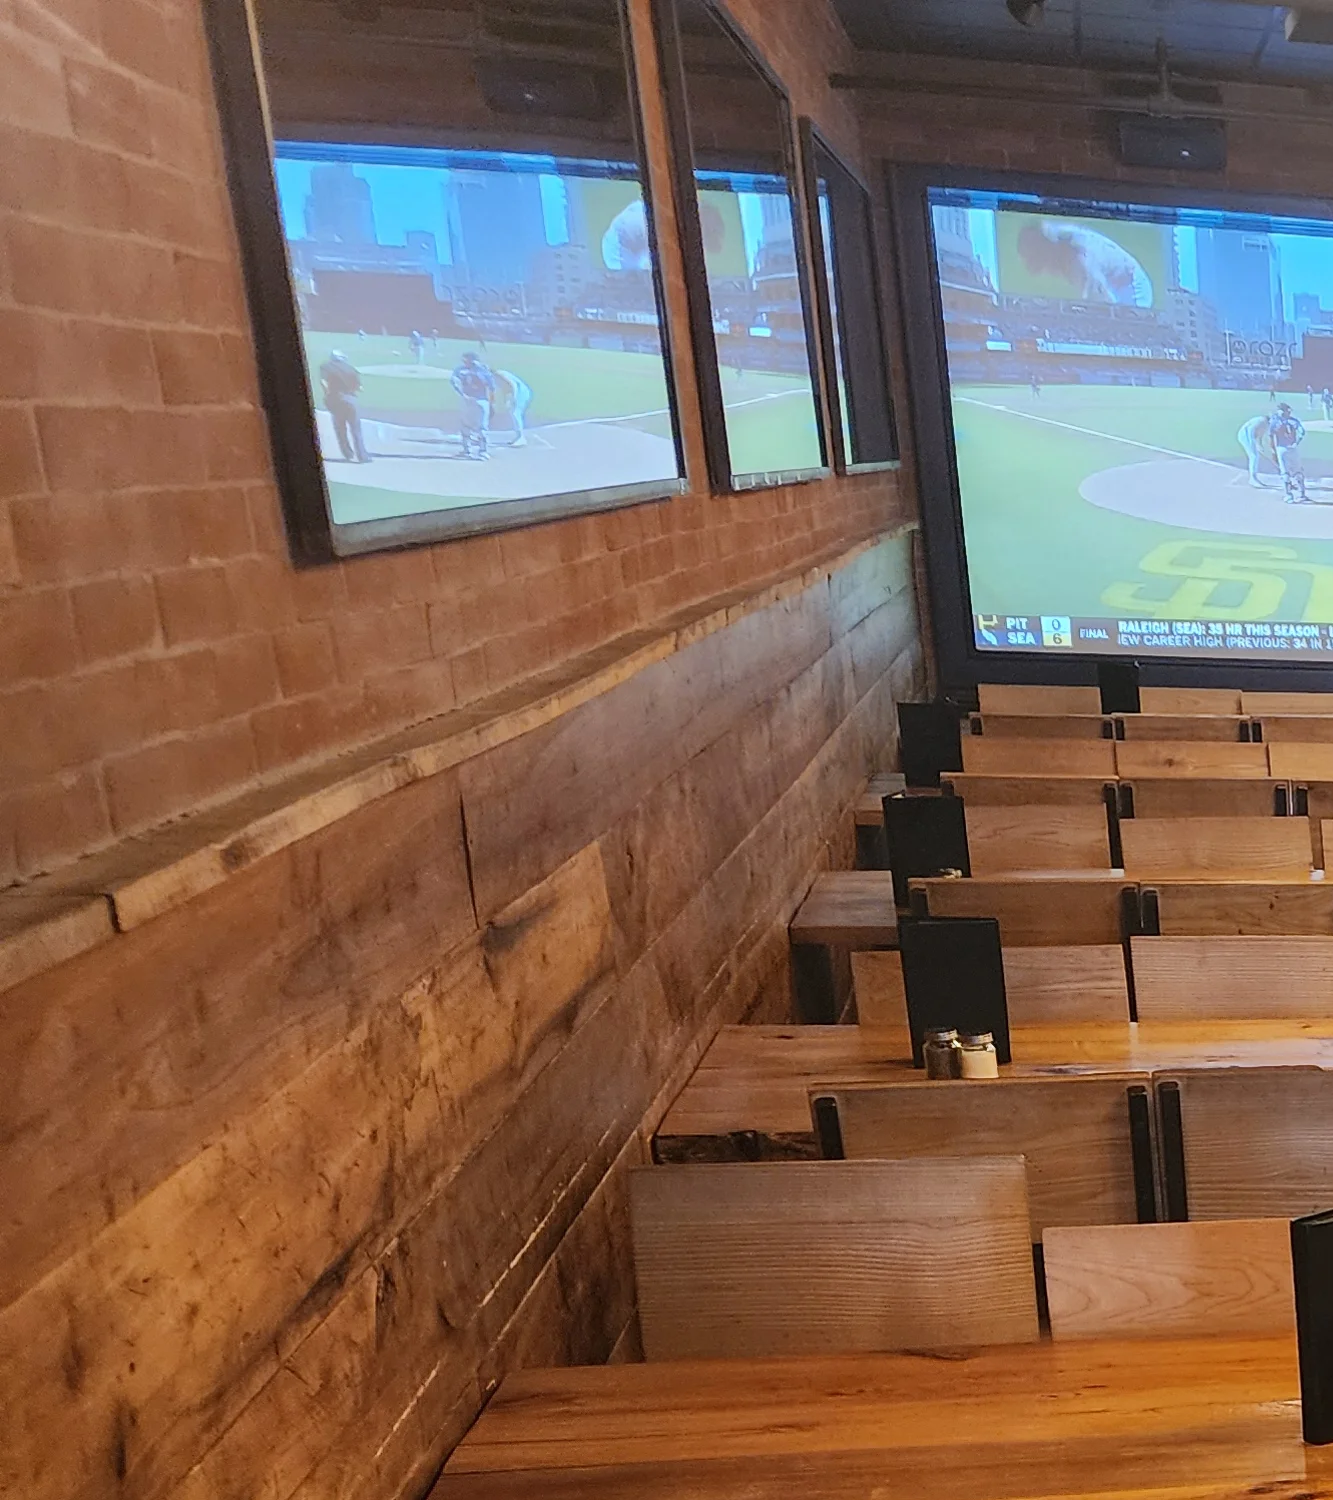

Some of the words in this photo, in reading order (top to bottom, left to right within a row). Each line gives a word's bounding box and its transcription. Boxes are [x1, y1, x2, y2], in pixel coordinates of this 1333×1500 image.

[1006, 617, 1028, 630] PIT
[1118, 621, 1169, 634] RALEIGH
[1226, 623, 1243, 636] HR
[1244, 623, 1271, 637] THIS
[1273, 624, 1320, 638] SEASON
[1006, 632, 1036, 645] SEA
[1053, 635, 1062, 645] 6
[1079, 628, 1110, 640] FINAL
[1143, 634, 1191, 647] CAREER
[1193, 635, 1223, 648] HIGH
